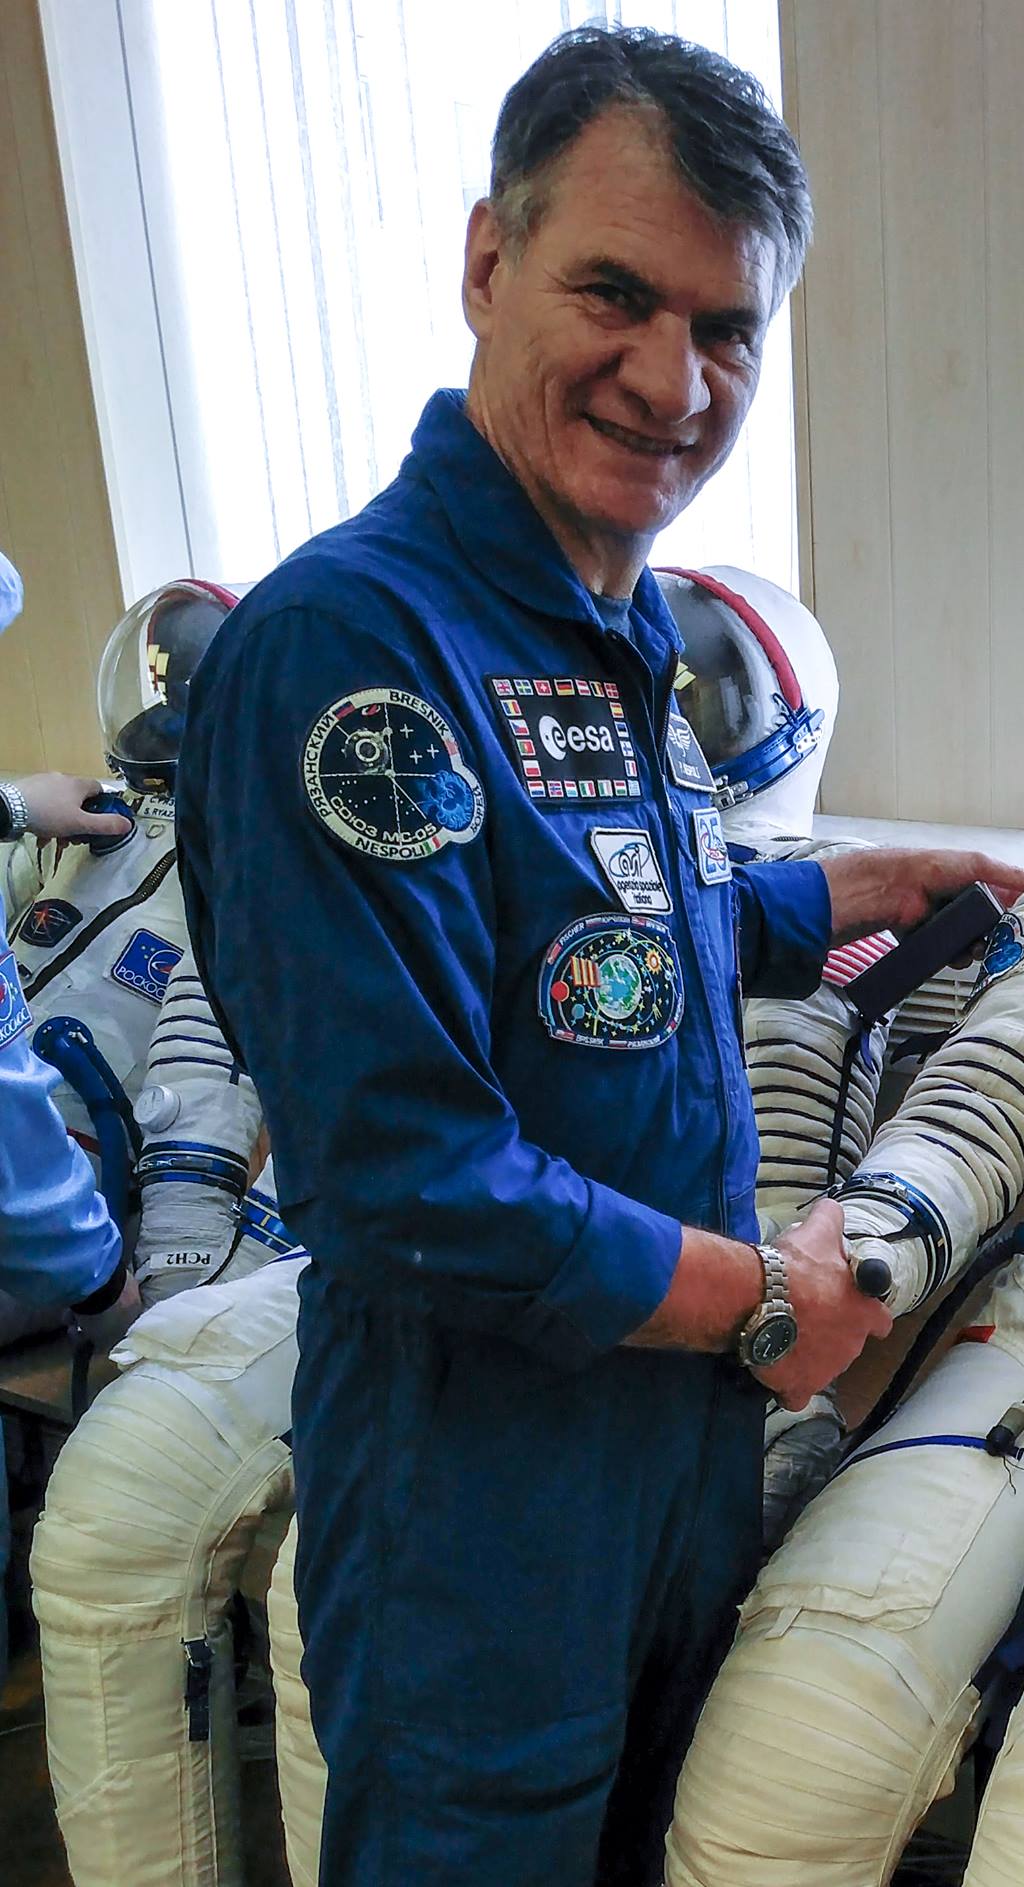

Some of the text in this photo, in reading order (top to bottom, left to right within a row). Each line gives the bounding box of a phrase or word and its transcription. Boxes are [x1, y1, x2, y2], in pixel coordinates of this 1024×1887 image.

[389, 691, 449, 736] BRESNIK
[567, 724, 615, 752] esa
[306, 712, 335, 817] РЯЗАНСКИЙ
[331, 796, 437, 843] СОЮЗ МС-05
[355, 837, 425, 858] NESPOLI
